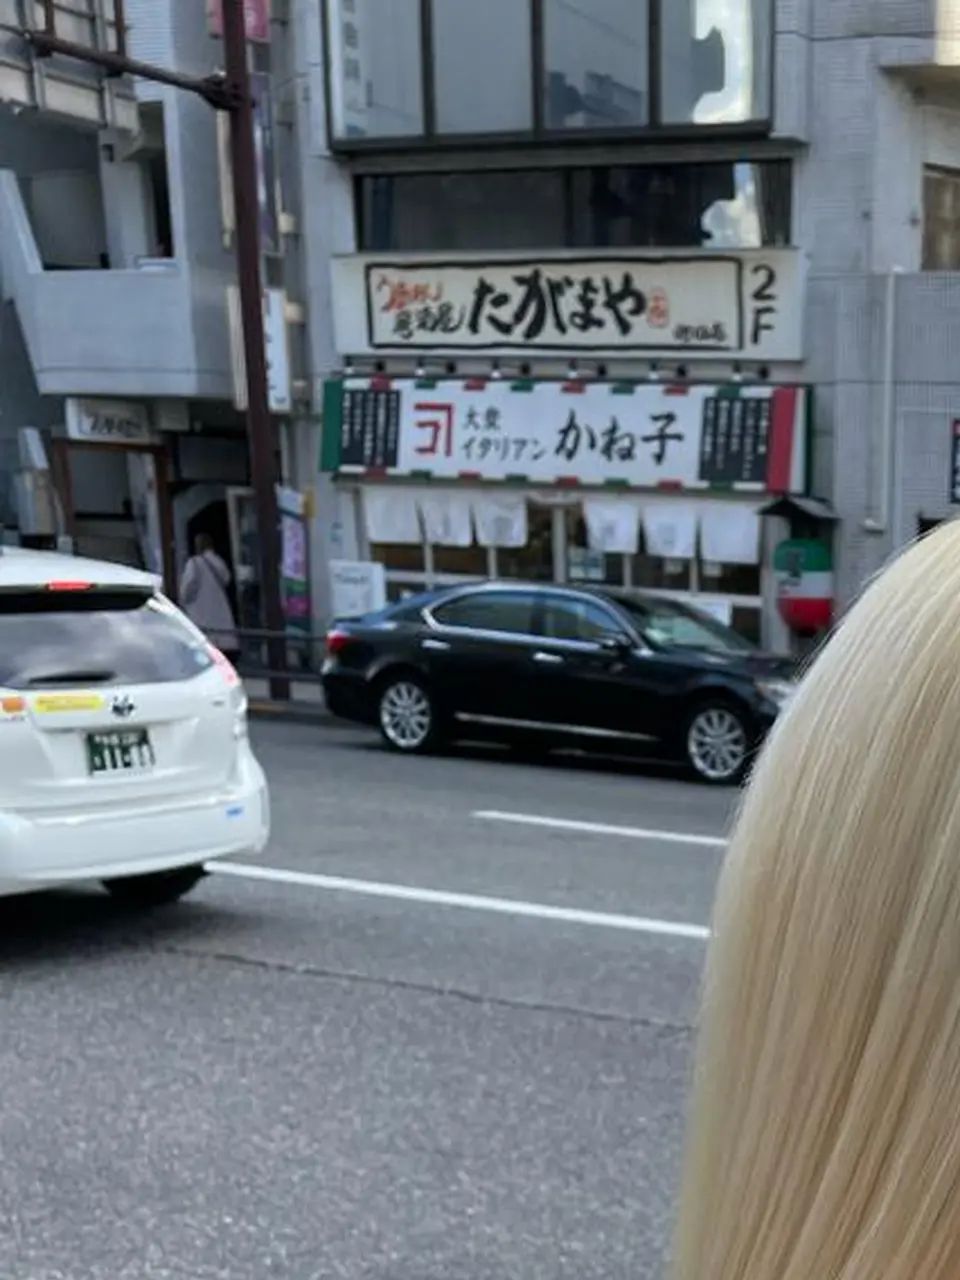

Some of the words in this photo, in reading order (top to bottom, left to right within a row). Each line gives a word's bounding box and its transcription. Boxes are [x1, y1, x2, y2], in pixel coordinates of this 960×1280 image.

[468, 268, 647, 339] たがまや
[462, 437, 546, 461] イタリアン
[555, 408, 685, 465] かね子
